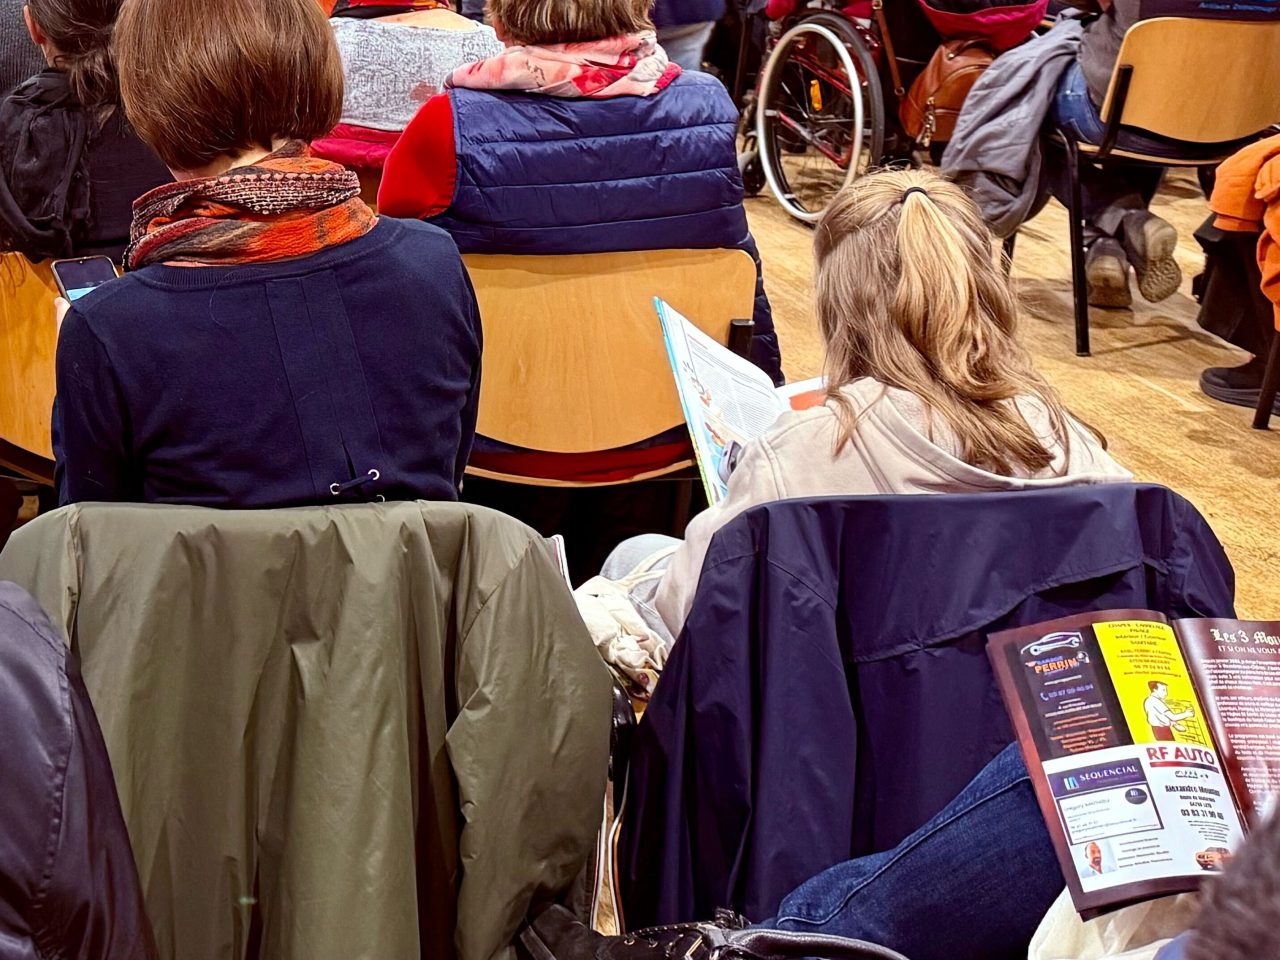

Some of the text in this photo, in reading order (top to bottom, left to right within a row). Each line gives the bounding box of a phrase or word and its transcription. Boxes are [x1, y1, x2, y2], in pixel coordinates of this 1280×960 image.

[1210, 628, 1237, 643] Les
[1238, 630, 1249, 643] 3
[1146, 746, 1169, 761] RF
[1174, 746, 1215, 765] AUTO
[1079, 765, 1138, 781] SEQUENCIAL
